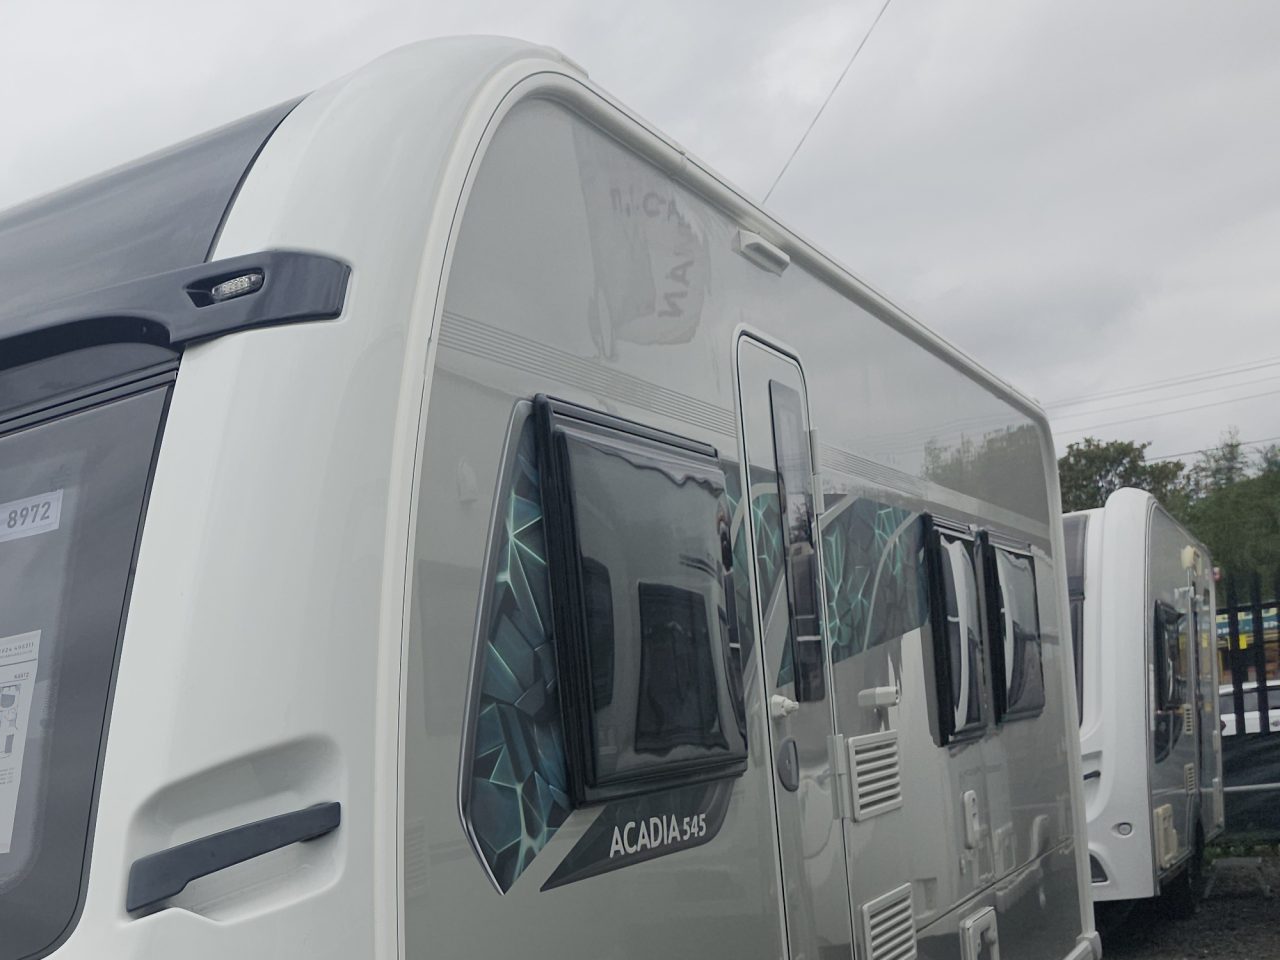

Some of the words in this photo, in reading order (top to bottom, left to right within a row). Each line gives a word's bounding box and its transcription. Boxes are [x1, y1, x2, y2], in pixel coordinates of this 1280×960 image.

[7, 501, 51, 529] 8972
[609, 813, 681, 859] ACADIA
[682, 813, 707, 841] 545
